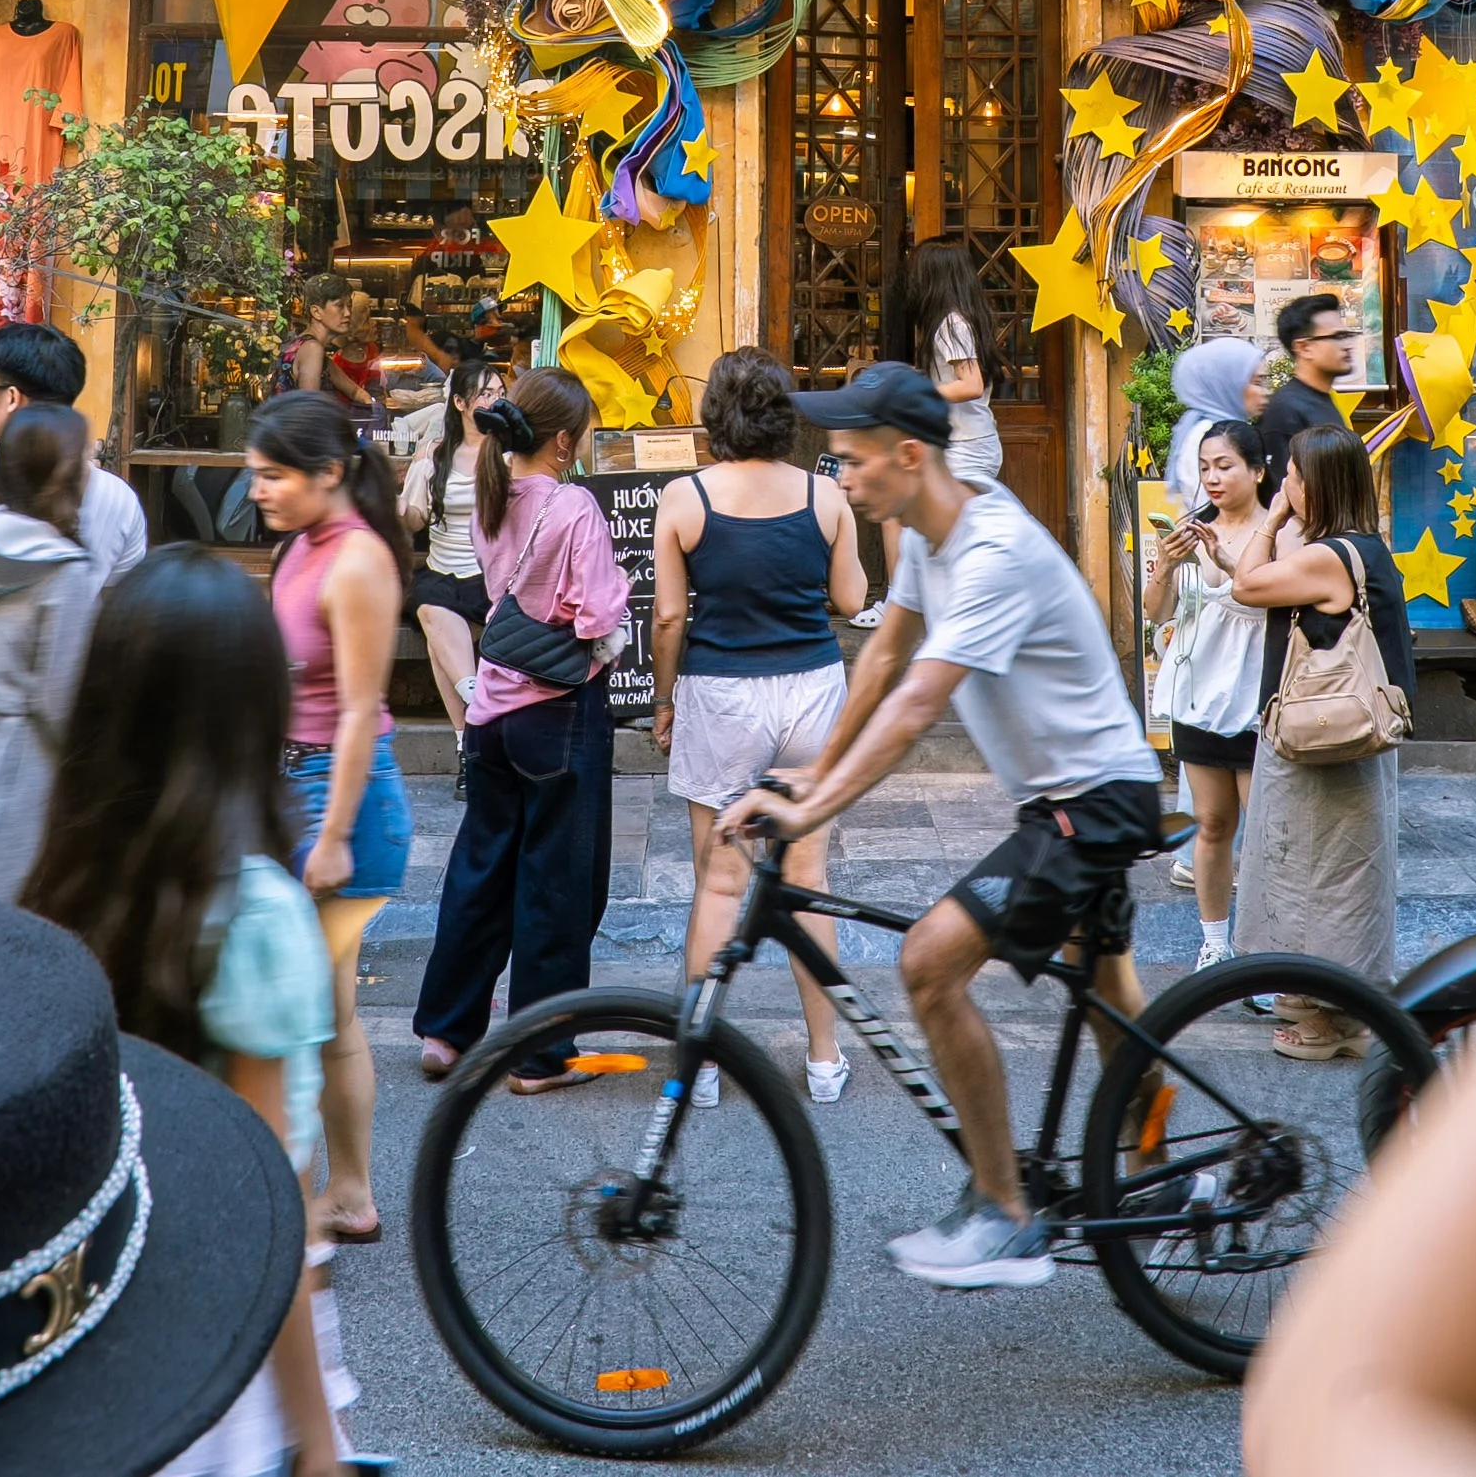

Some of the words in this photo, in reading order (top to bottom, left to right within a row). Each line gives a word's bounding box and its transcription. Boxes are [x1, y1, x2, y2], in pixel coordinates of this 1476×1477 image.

[1236, 182, 1263, 197] Café
[1266, 182, 1280, 195] &
[1283, 182, 1348, 196] Restaurant
[812, 205, 868, 224] OPEN
[819, 226, 838, 235] 7AM
[1260, 243, 1278, 251] WE
[1280, 242, 1301, 251] ARE
[1265, 254, 1295, 263] OPEN
[613, 481, 662, 509] HƯỚN
[609, 509, 627, 539] ỬI
[628, 518, 653, 538] XE
[609, 693, 626, 706] XIN
